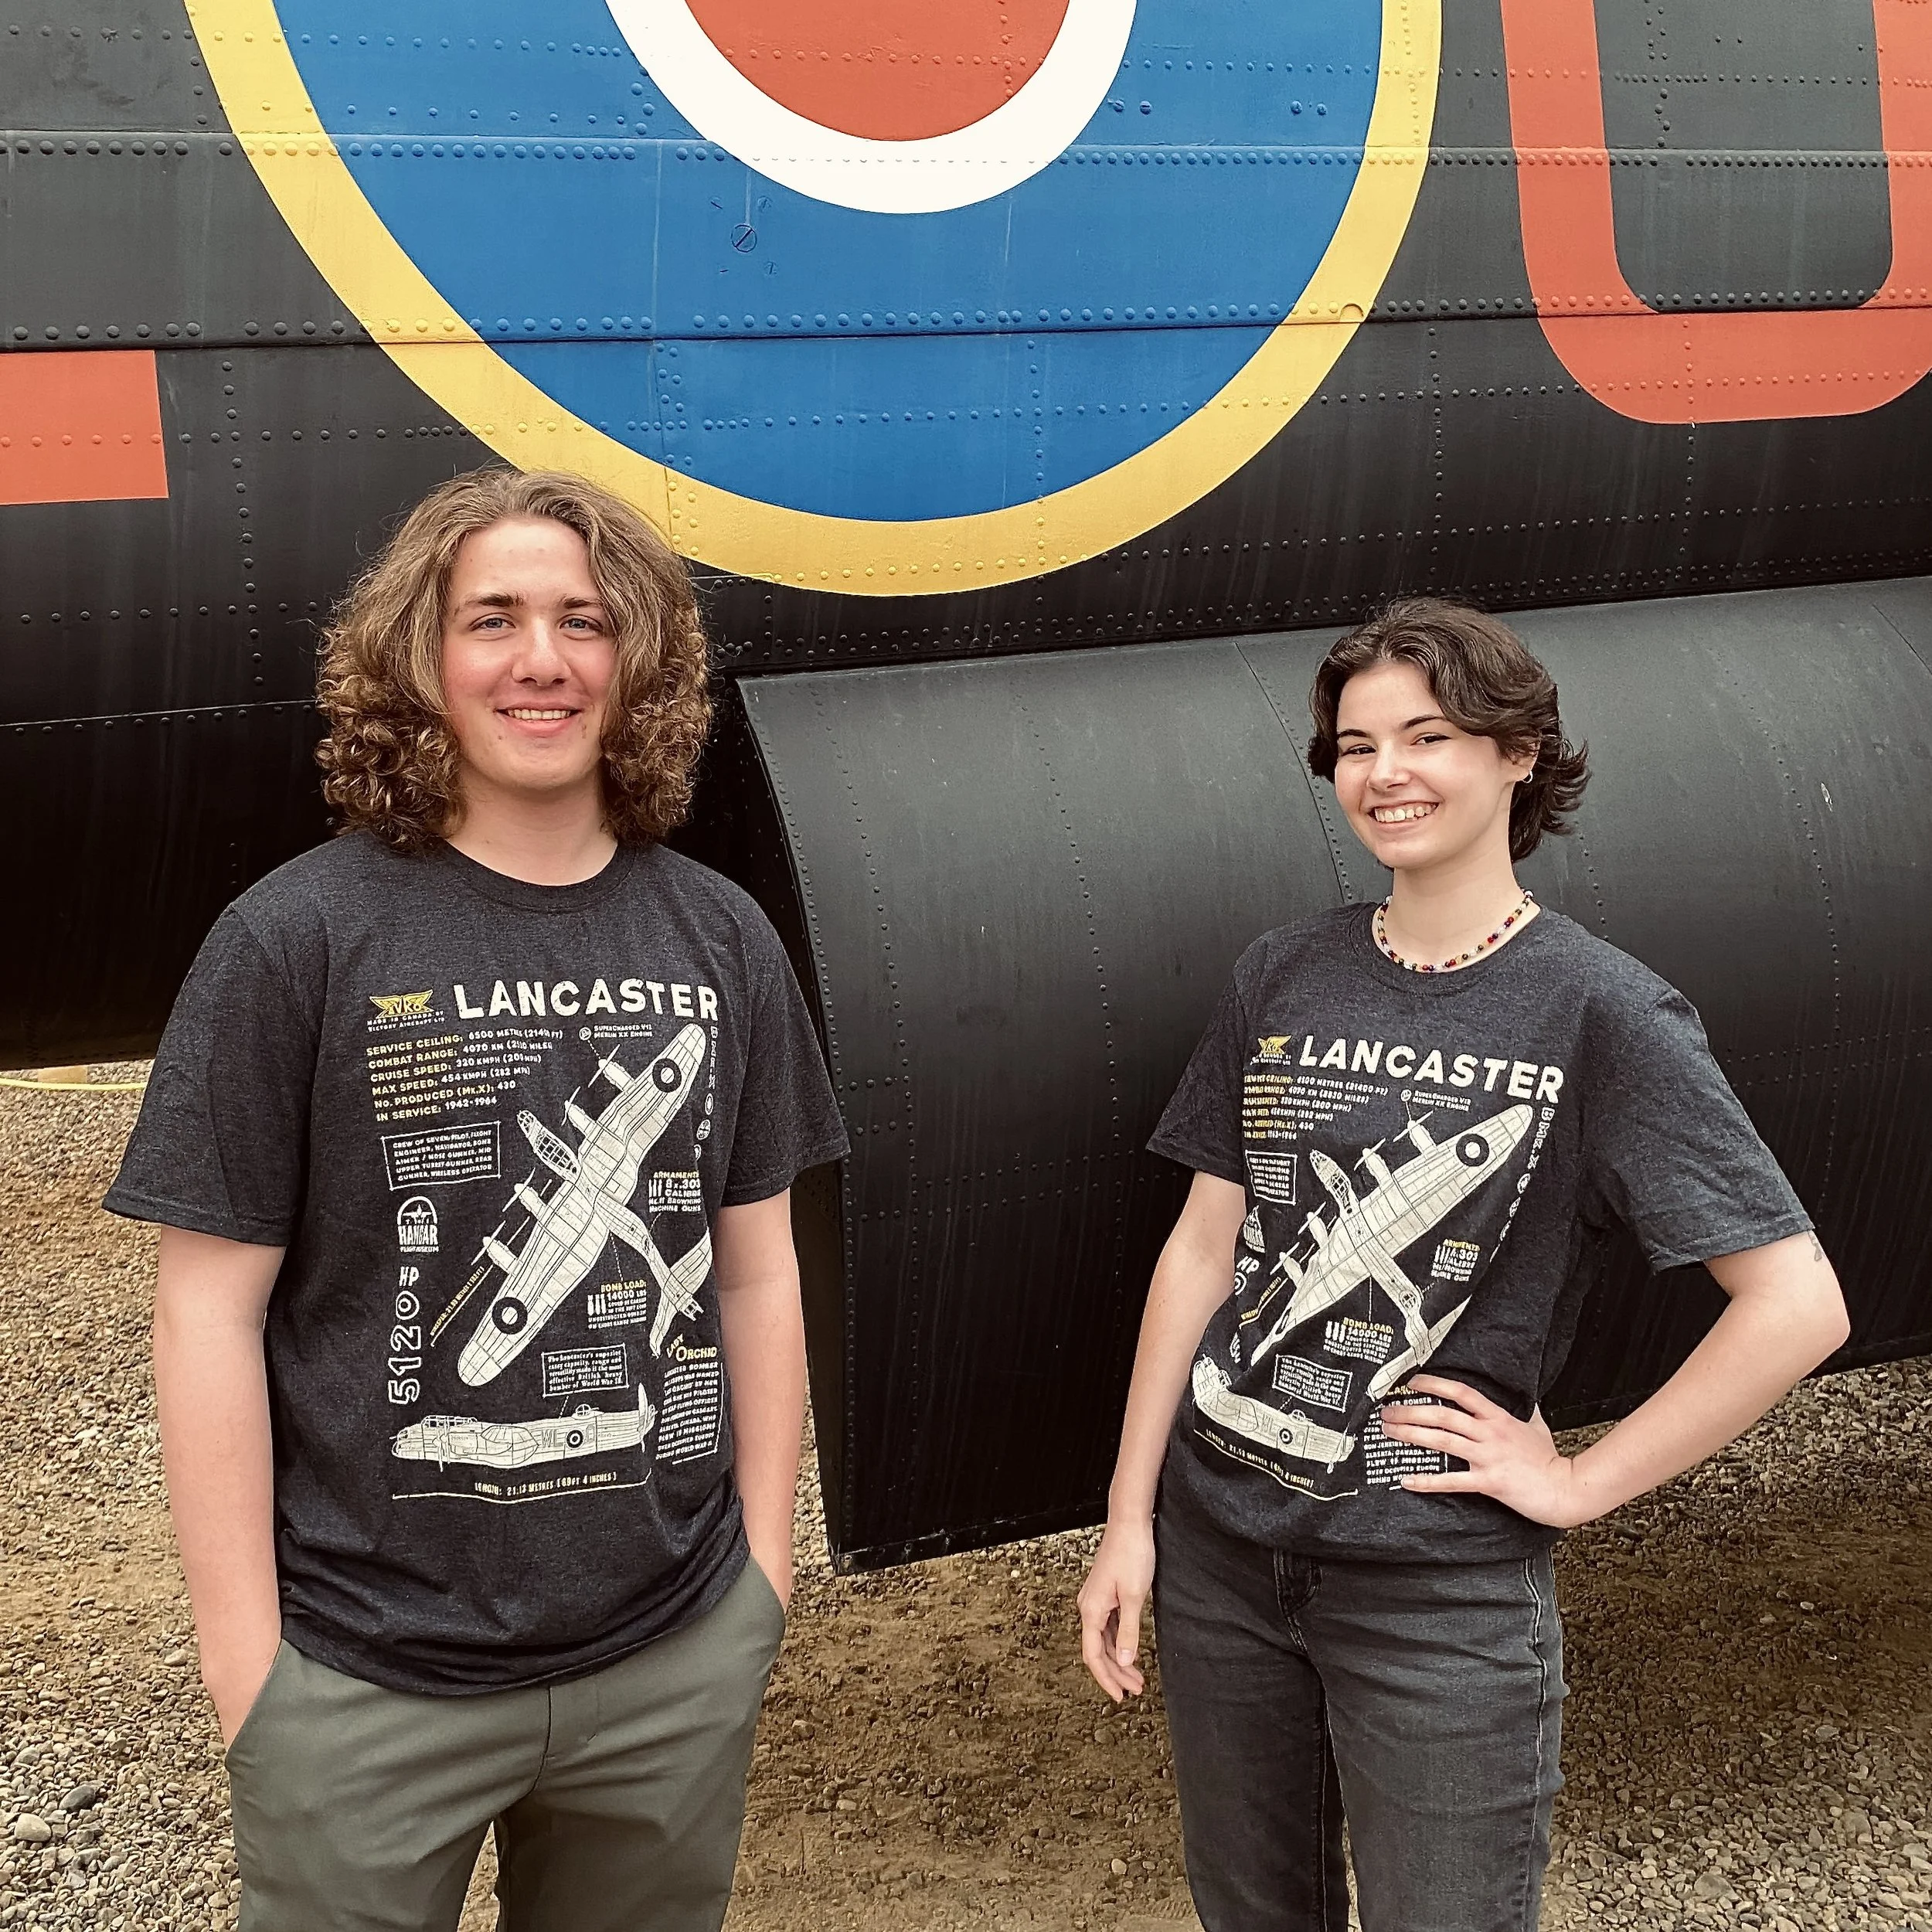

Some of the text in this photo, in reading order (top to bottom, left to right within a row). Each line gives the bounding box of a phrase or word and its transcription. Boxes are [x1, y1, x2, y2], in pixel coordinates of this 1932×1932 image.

[453, 978, 719, 1021] LANCASTER
[366, 1041, 413, 1057] SERVICE
[415, 1034, 464, 1049] CEILING:
[468, 1030, 494, 1041] 6500
[368, 1054, 413, 1070] COMBAT
[415, 1048, 458, 1063] RANGE:
[462, 1043, 489, 1054] 4070
[370, 1068, 410, 1083] CRUISE
[413, 1063, 452, 1077] SPEED:
[455, 1057, 475, 1069] 320
[476, 1055, 502, 1066] KMPH
[1298, 1034, 1565, 1104] LANCASTER
[371, 1083, 398, 1097] MAX
[400, 1078, 439, 1093] SPEED:
[440, 1073, 461, 1083] 454
[394, 1089, 454, 1107] PRODUCED
[497, 1080, 517, 1090] 430
[376, 1095, 498, 1122] IN SERVICE: 1942-1964
[393, 1139, 413, 1149] CREW
[397, 1223, 439, 1246] HANGAR
[1236, 1254, 1260, 1274] HP
[399, 1265, 420, 1287] HP
[606, 1290, 635, 1301] 14000
[1347, 1325, 1378, 1338] 14000
[666, 1332, 685, 1359] LADY
[675, 1345, 718, 1362] ORCHID
[547, 1355, 559, 1363] The
[582, 1475, 588, 1485] 4
